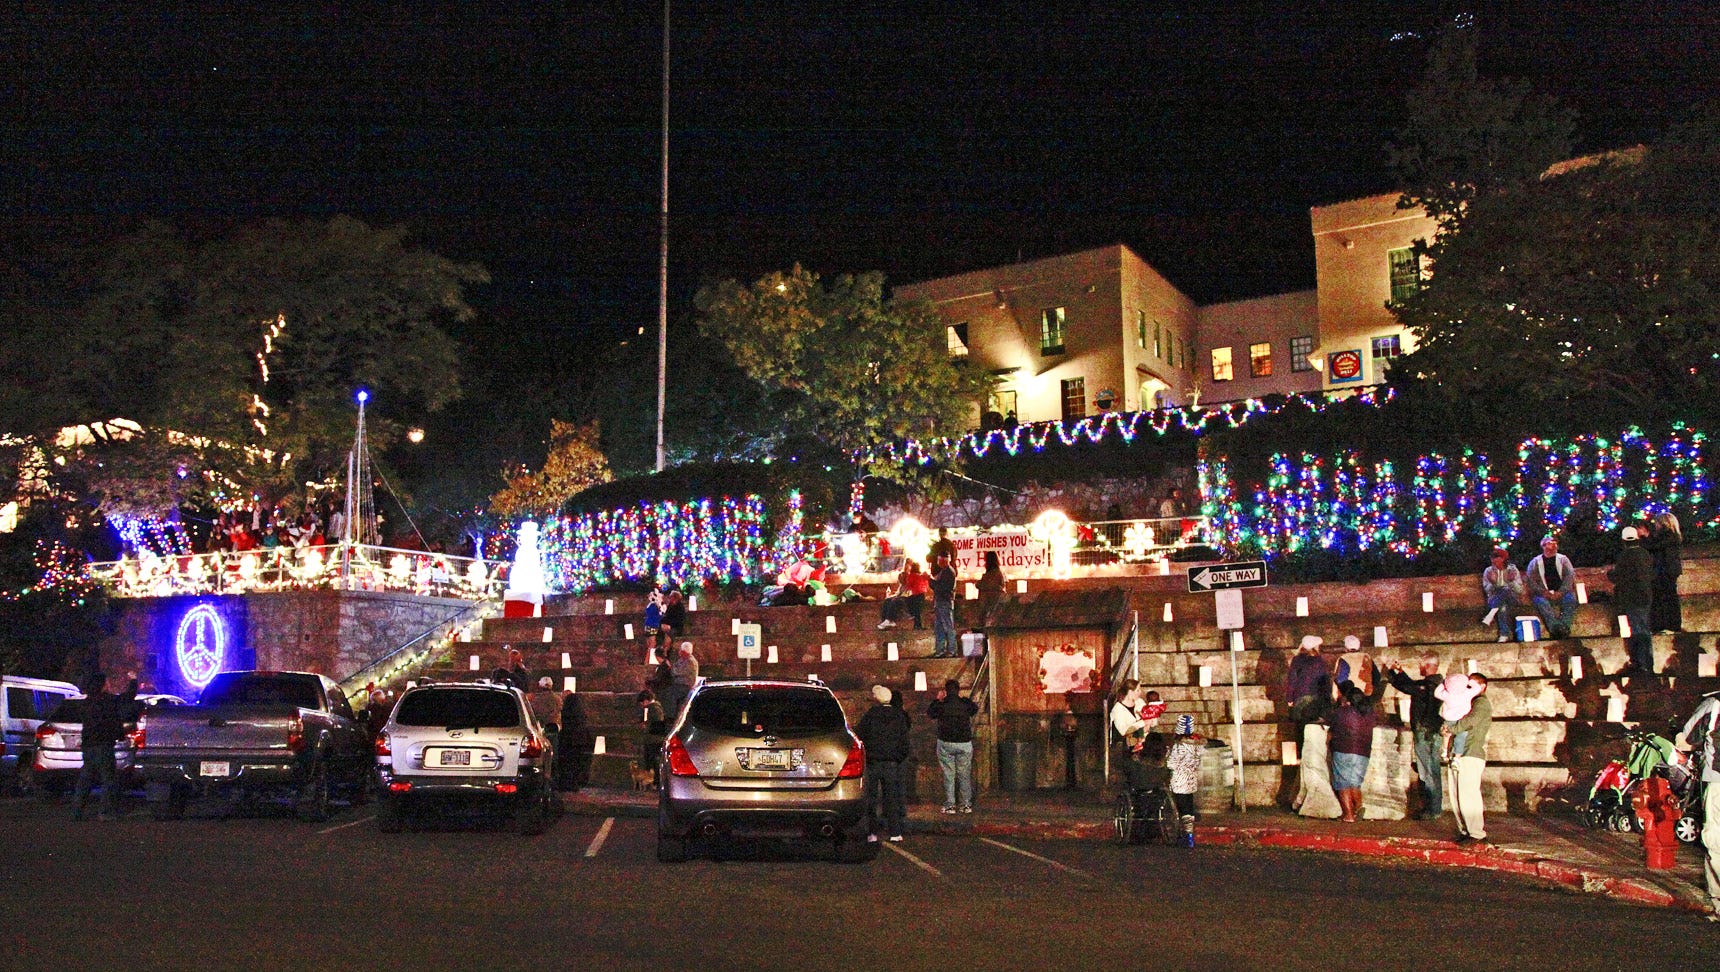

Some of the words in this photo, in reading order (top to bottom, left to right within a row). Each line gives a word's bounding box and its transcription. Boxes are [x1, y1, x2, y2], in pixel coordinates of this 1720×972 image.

[952, 538, 974, 550] ROME
[976, 536, 1007, 549] WISHES
[1010, 535, 1027, 547] YOU
[976, 548, 1046, 569] Hlidays!
[1211, 572, 1232, 582] ONE
[1235, 569, 1256, 580] WAY
